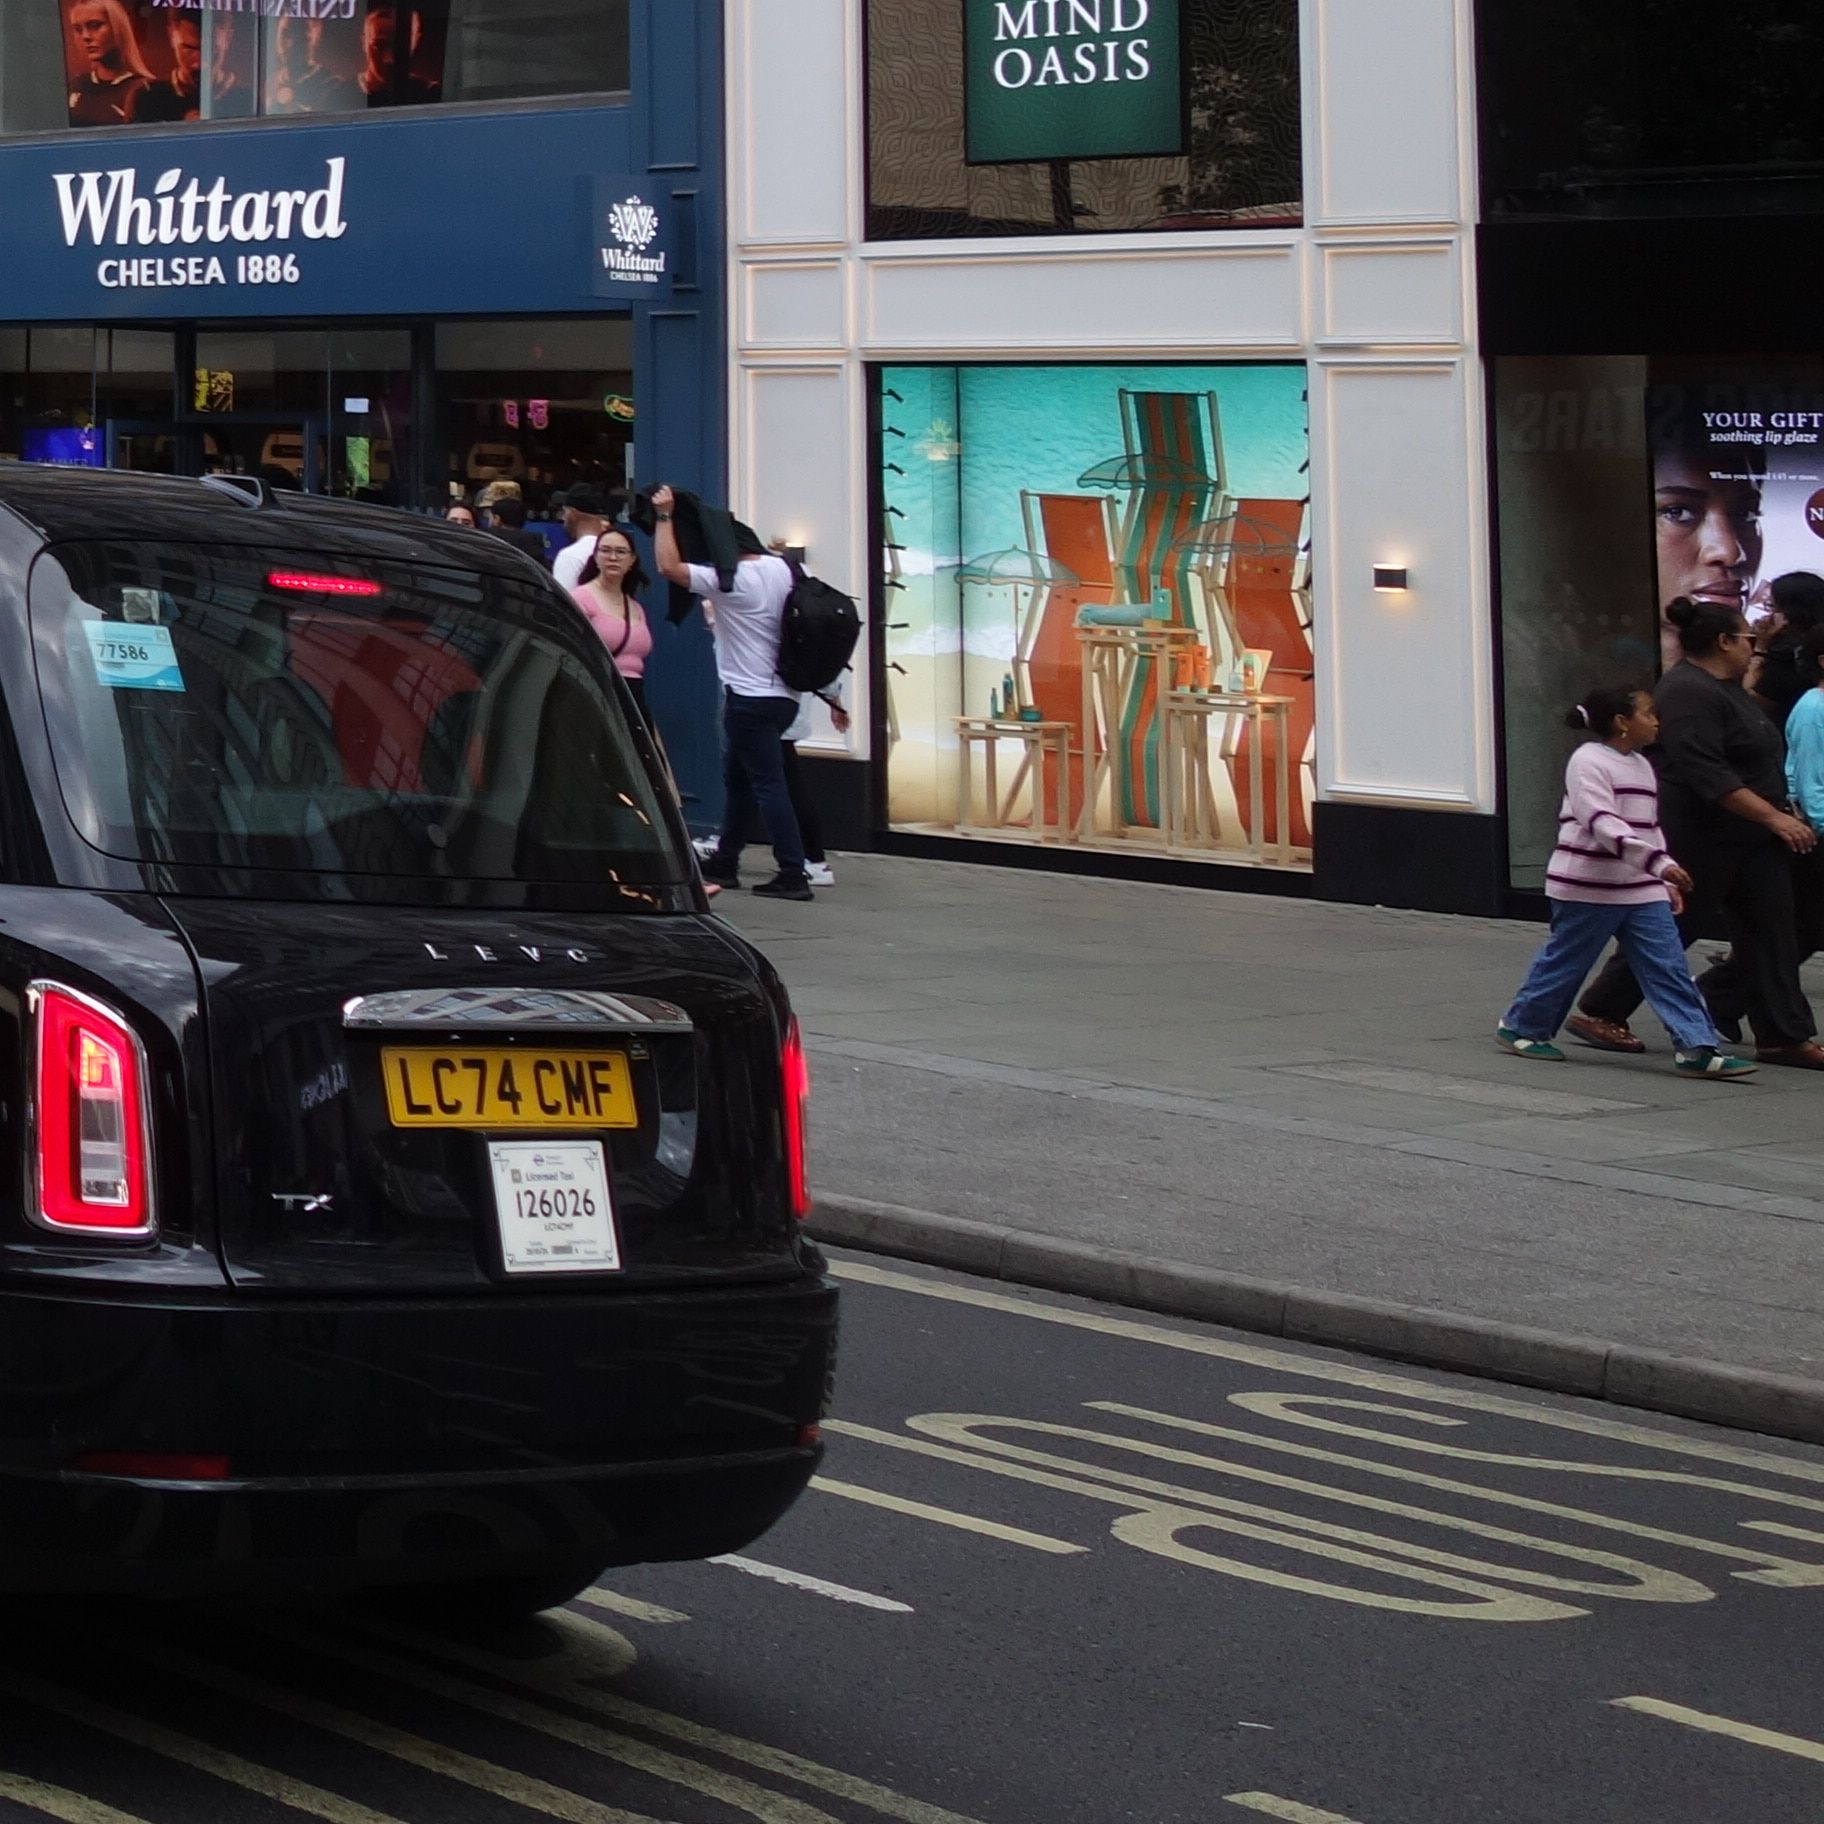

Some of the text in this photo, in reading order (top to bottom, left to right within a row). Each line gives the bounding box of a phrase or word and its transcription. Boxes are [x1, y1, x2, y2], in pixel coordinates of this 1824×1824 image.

[993, 38, 1150, 89] OASIS
[52, 156, 348, 247] Whittard
[97, 253, 300, 288] CHELSEA 1886
[601, 247, 666, 272] Whittard
[610, 271, 642, 282] CHELSEA
[1702, 412, 1824, 428] YOUR GIFT
[1710, 430, 1819, 446] soothing lip glaze
[96, 643, 149, 661] 77586
[423, 942, 590, 964] LEVC
[398, 1057, 523, 1116] LC74
[533, 1059, 613, 1117] CMF
[525, 1172, 559, 1182] Licensed
[271, 1192, 335, 1213] TX
[515, 1188, 596, 1219] 126026
